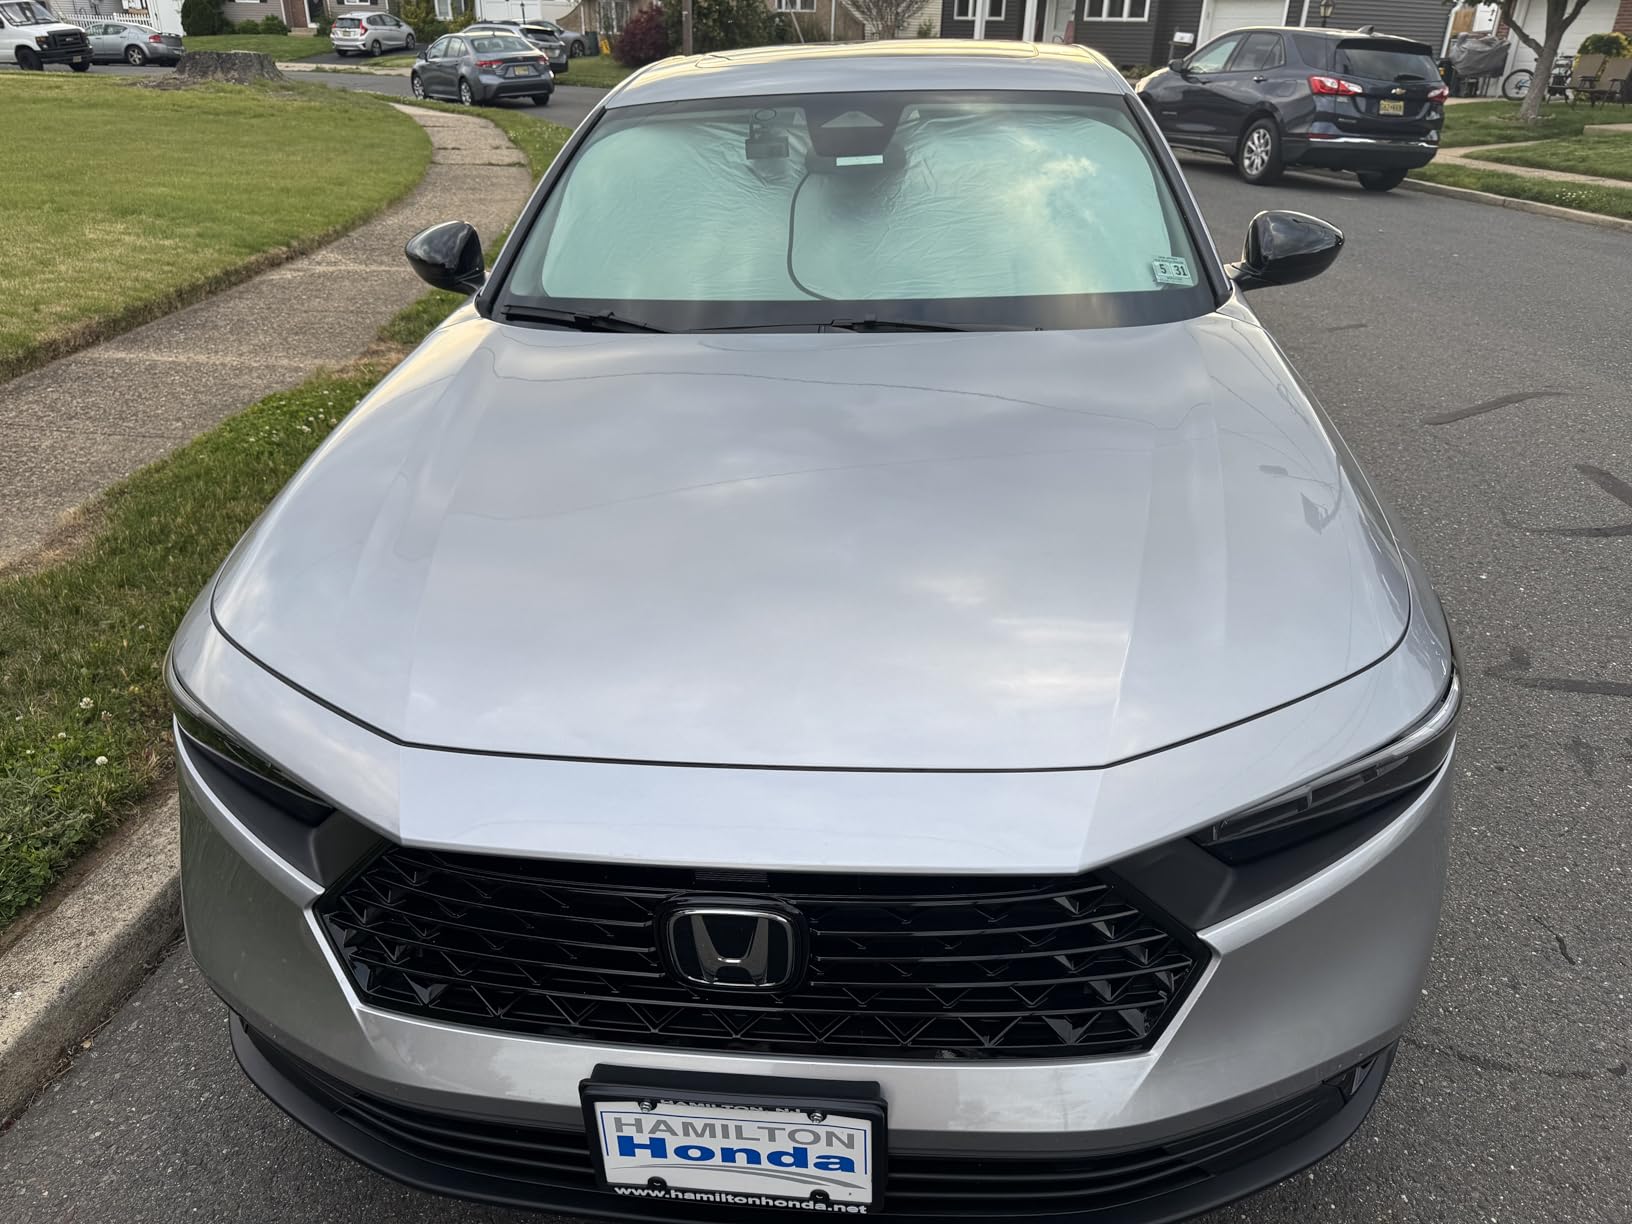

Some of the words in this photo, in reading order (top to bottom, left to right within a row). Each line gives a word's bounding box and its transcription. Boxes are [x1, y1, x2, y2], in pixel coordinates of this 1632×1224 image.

[1159, 264, 1167, 274] 5
[1174, 265, 1187, 276] 31
[613, 1116, 855, 1150] HAMILTON
[616, 1135, 857, 1174] Honda
[614, 1186, 868, 1215] www.hamiltonhonda.net
